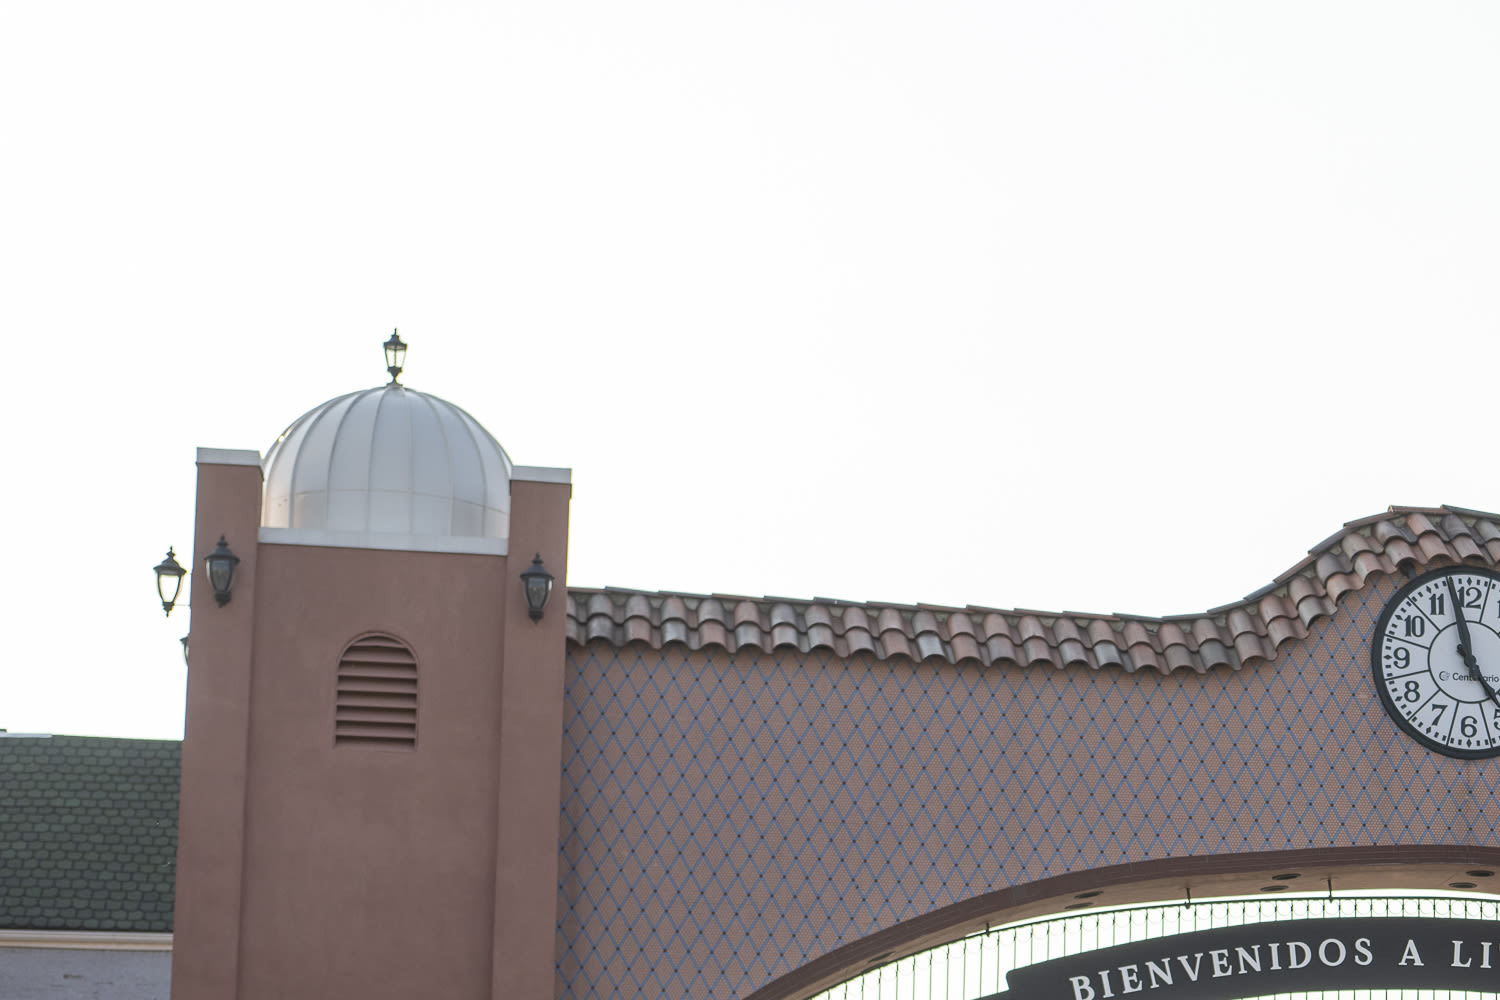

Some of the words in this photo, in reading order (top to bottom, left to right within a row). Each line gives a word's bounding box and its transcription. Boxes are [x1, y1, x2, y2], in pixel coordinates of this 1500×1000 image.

[1429, 594, 1445, 615] 11
[1457, 587, 1482, 609] 12
[1404, 615, 1425, 637] 10
[1393, 647, 1411, 669] 9
[1452, 672, 1500, 683] Centario
[1403, 681, 1421, 703] 8
[1432, 704, 1448, 726] 7
[1460, 715, 1478, 738] 6
[1398, 939, 1425, 966] A
